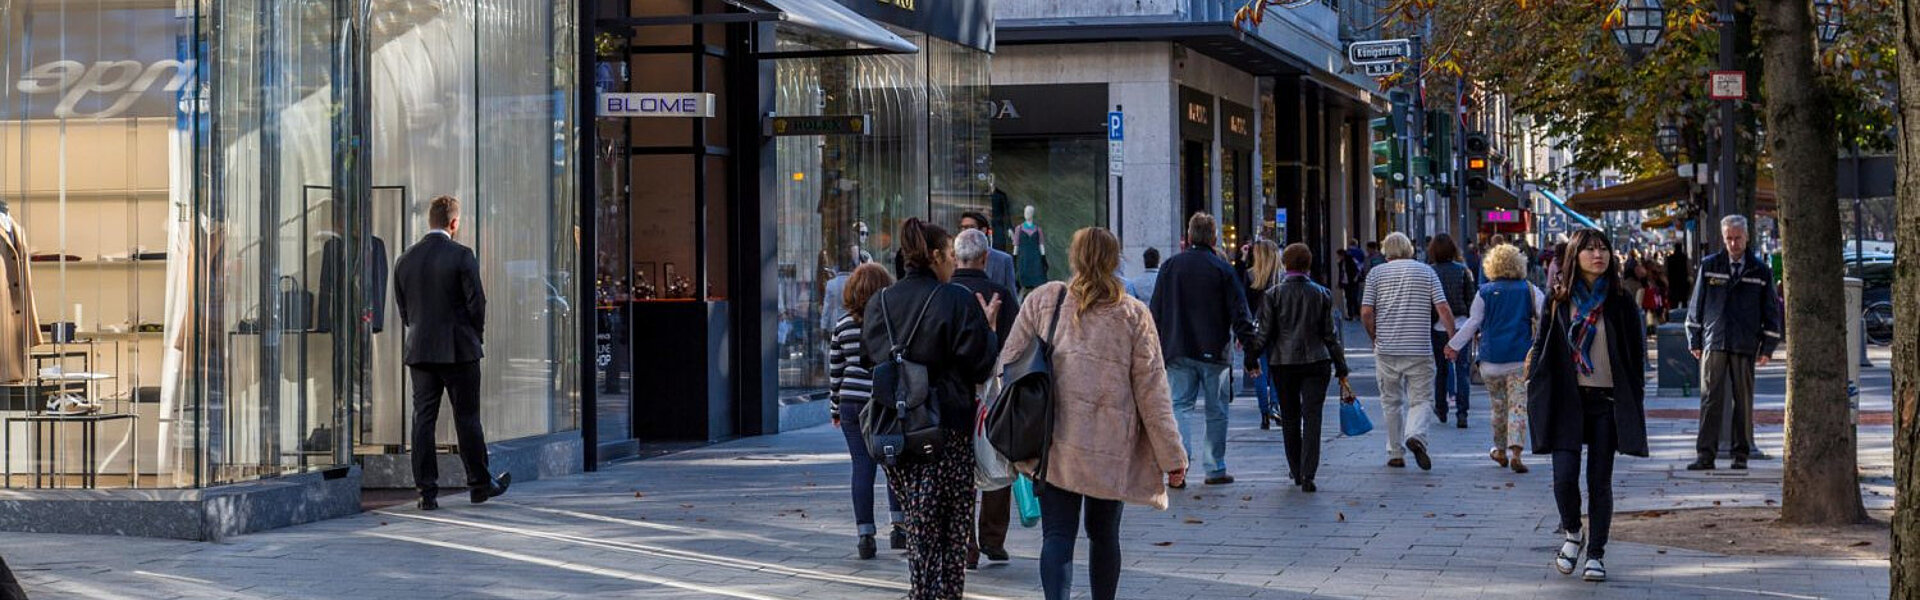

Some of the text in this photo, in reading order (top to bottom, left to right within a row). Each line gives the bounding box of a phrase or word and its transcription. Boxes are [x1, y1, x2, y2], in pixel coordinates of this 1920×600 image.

[1356, 45, 1402, 59] Königstraße
[607, 97, 696, 113] BLOME
[794, 119, 841, 131] ROLEX
[1111, 115, 1121, 137] P
